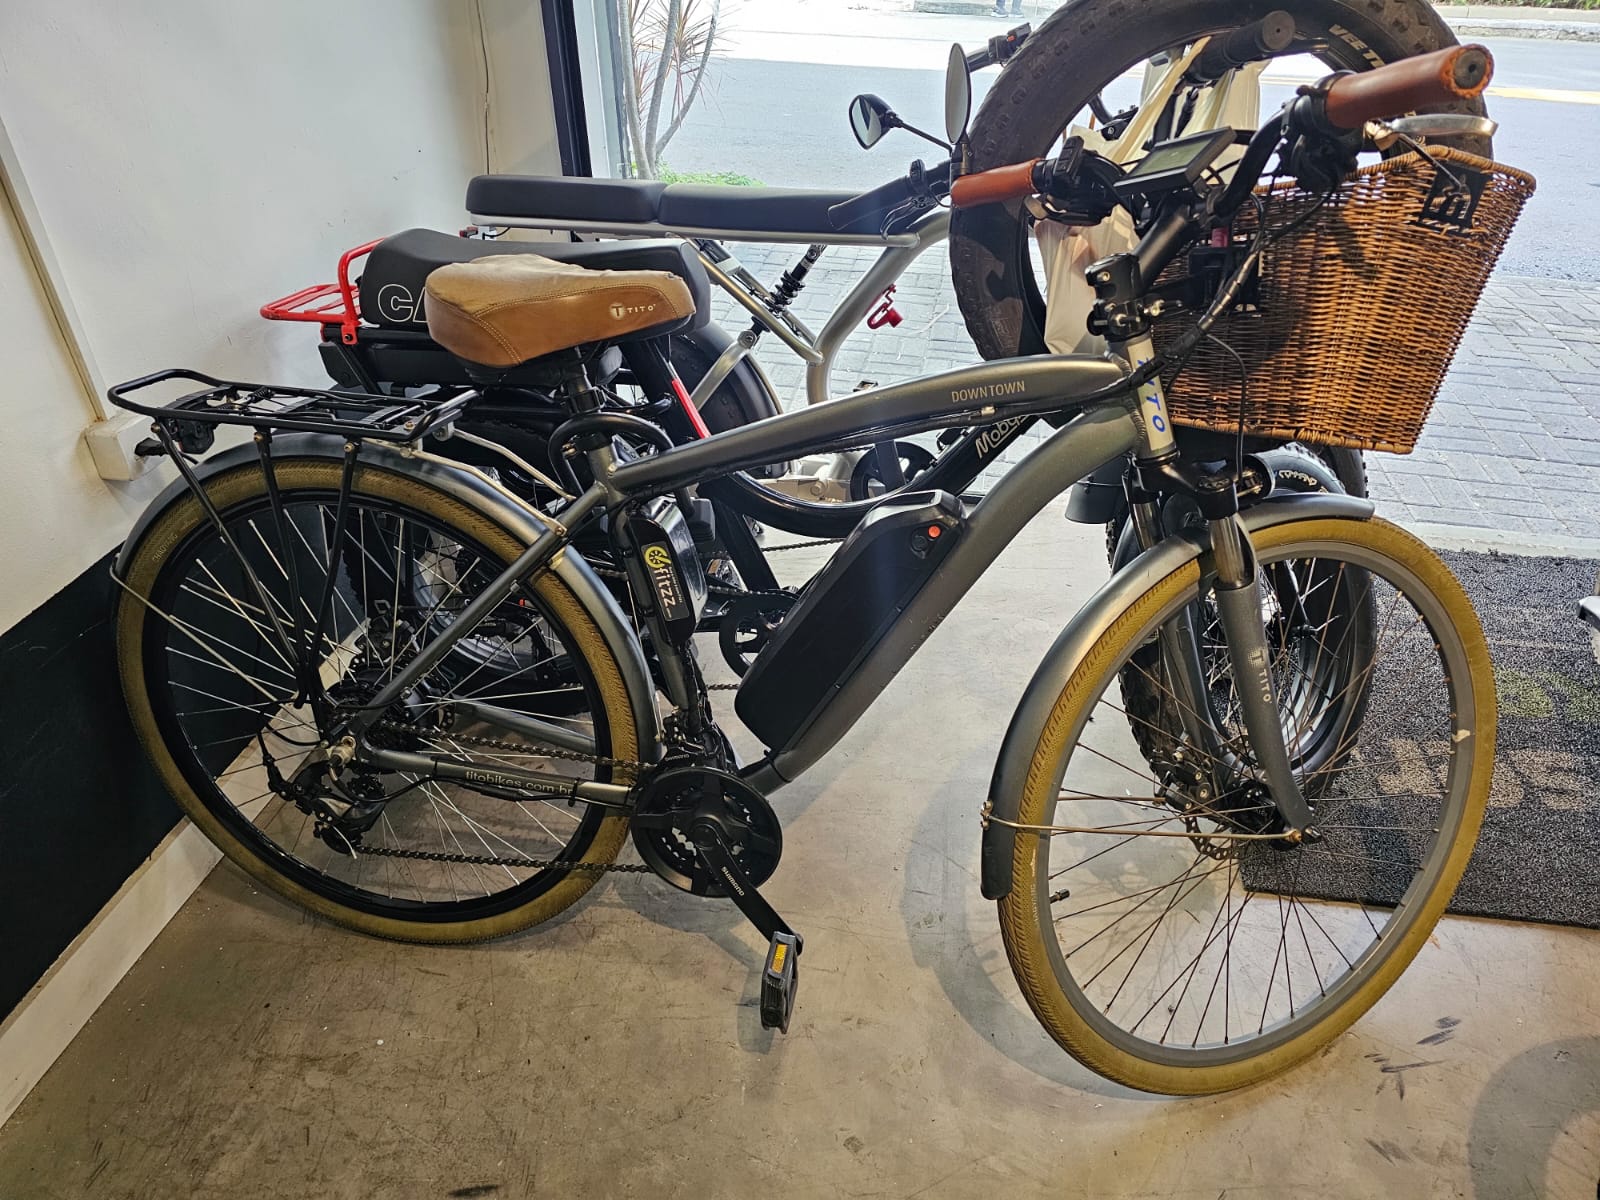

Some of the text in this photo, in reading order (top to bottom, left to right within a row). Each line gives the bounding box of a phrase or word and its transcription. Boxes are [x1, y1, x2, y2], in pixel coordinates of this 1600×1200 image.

[1328, 23, 1368, 50] VEE
[627, 305, 654, 314] TITO
[951, 380, 1026, 403] DOWNTOWN
[1259, 668, 1272, 702] TITO
